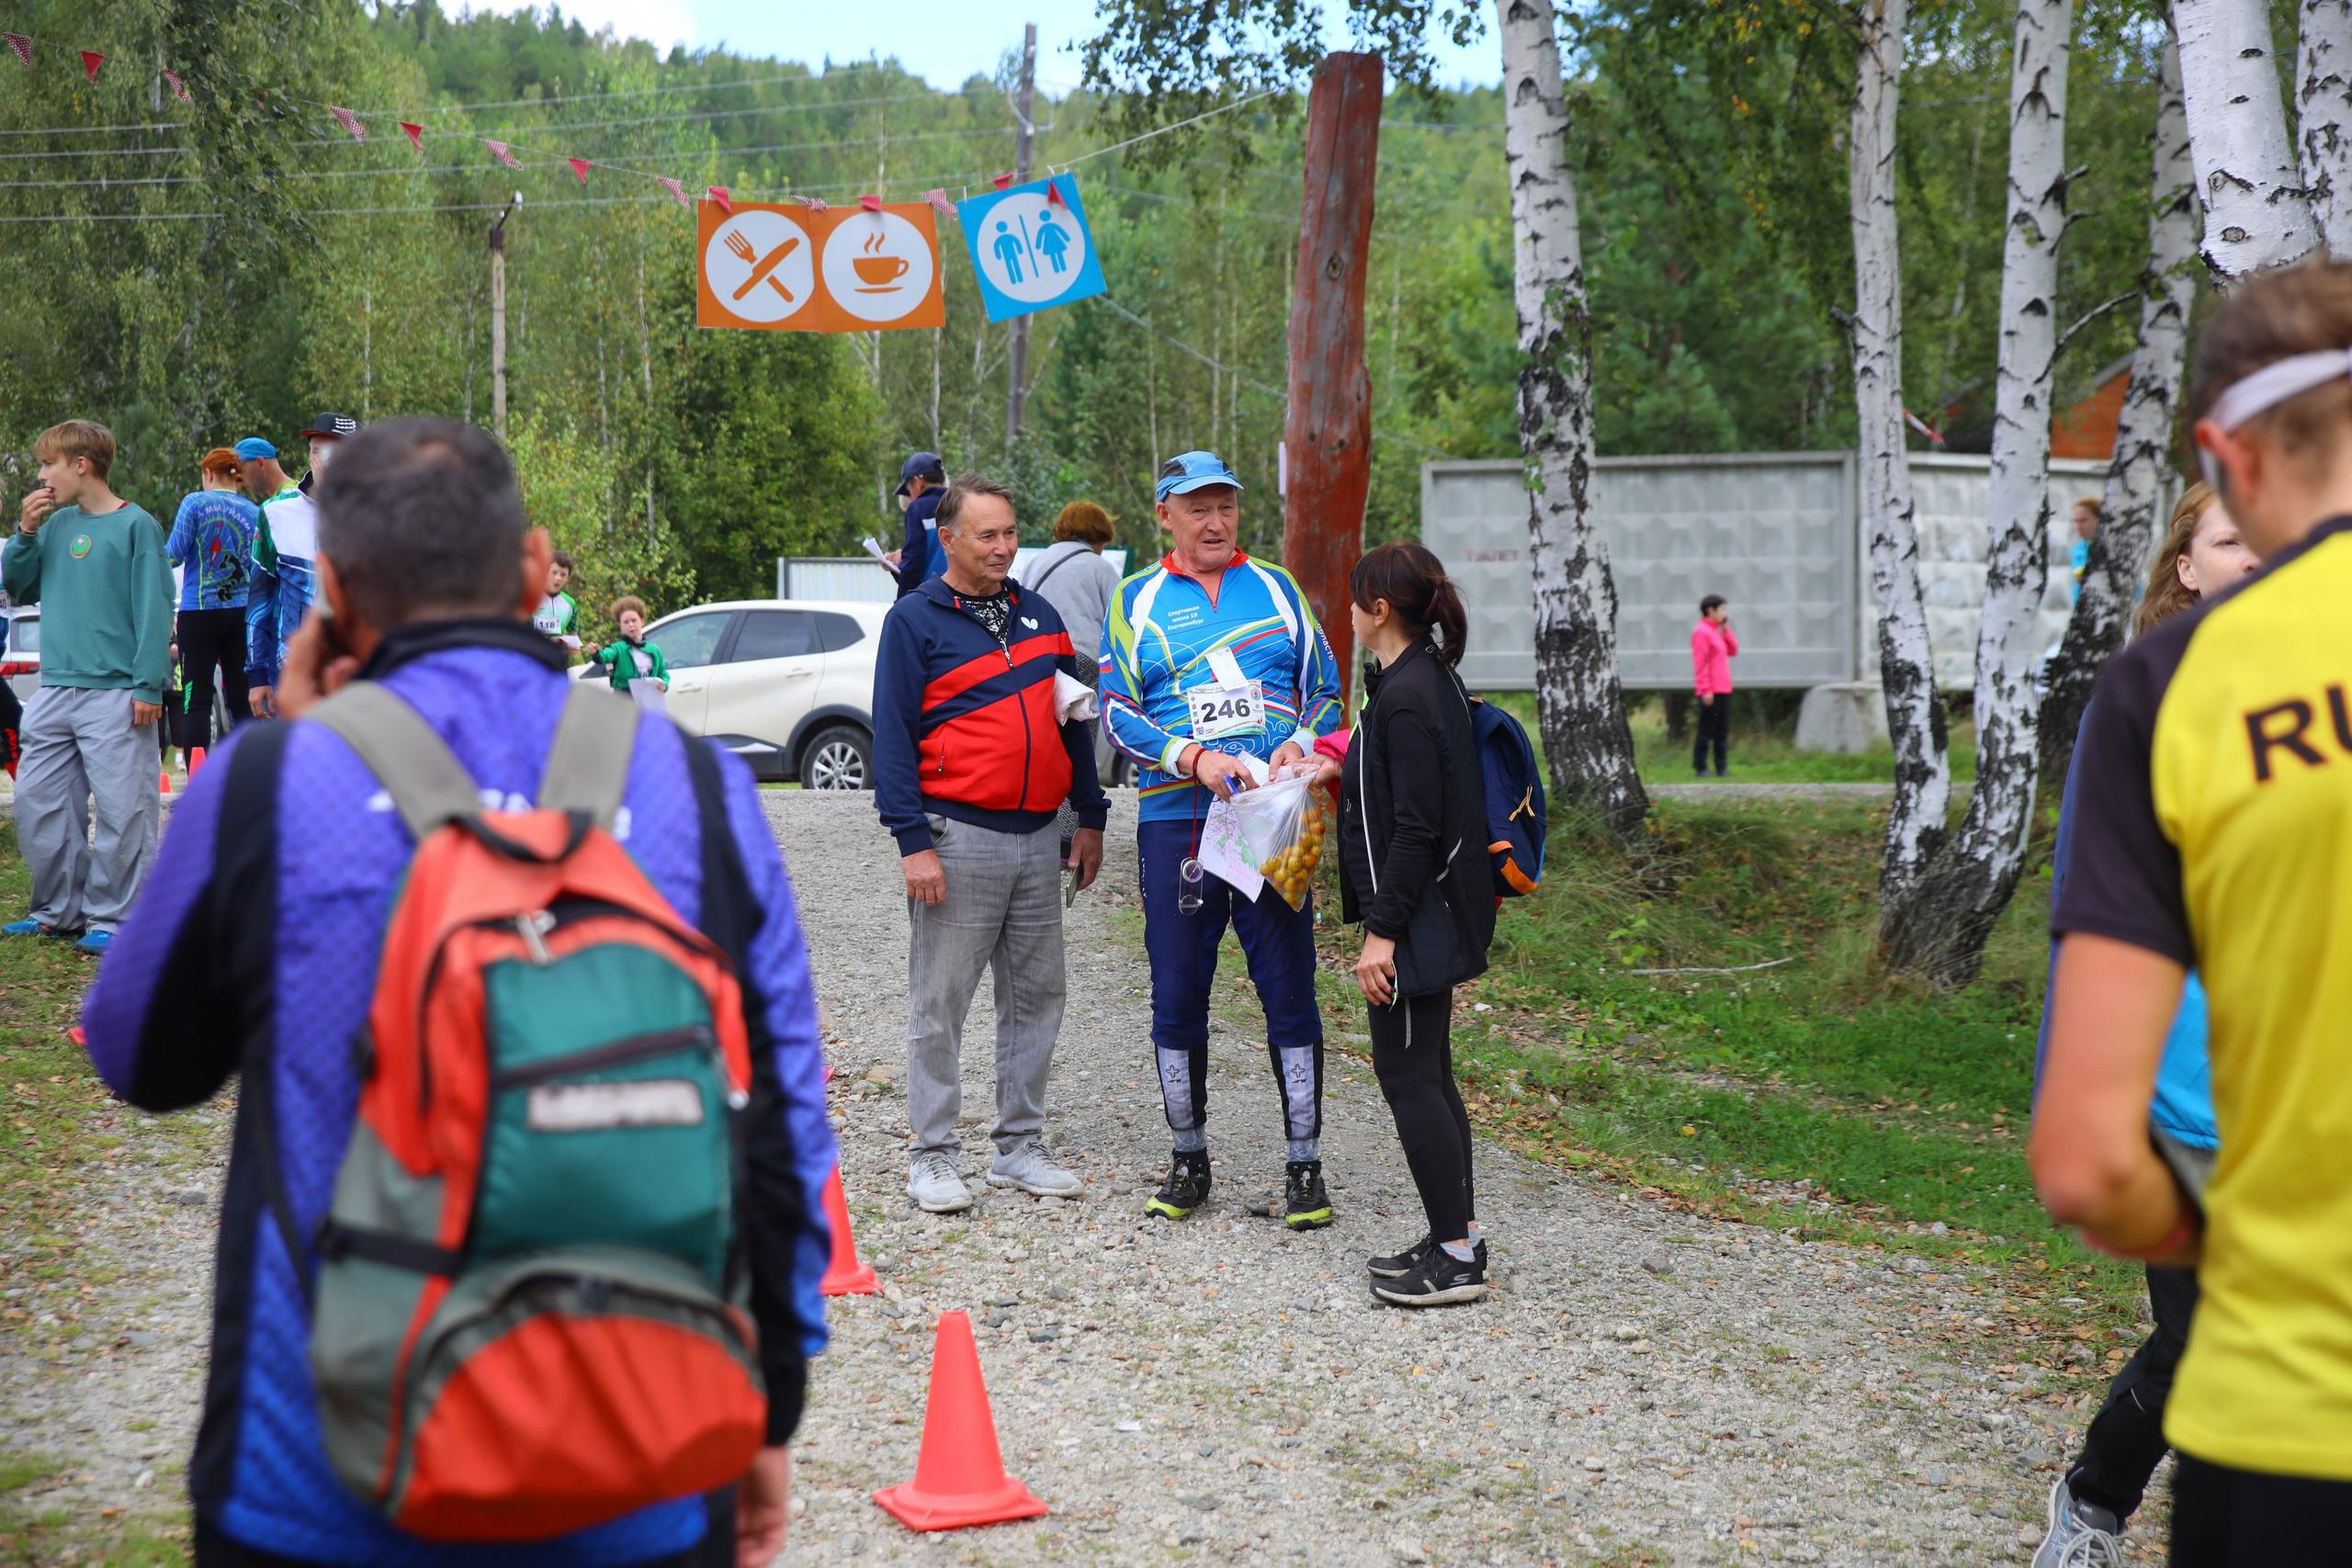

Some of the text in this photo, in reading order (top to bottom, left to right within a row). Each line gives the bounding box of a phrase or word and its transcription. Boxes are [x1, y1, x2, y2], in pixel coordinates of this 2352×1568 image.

[205, 504, 220, 513] МЫ
[1167, 605, 1200, 617] Спортивная
[1171, 615, 1190, 623] школа
[538, 621, 556, 629] 118
[1167, 618, 1204, 631] Екатеринбург
[1201, 698, 1251, 723] 246
